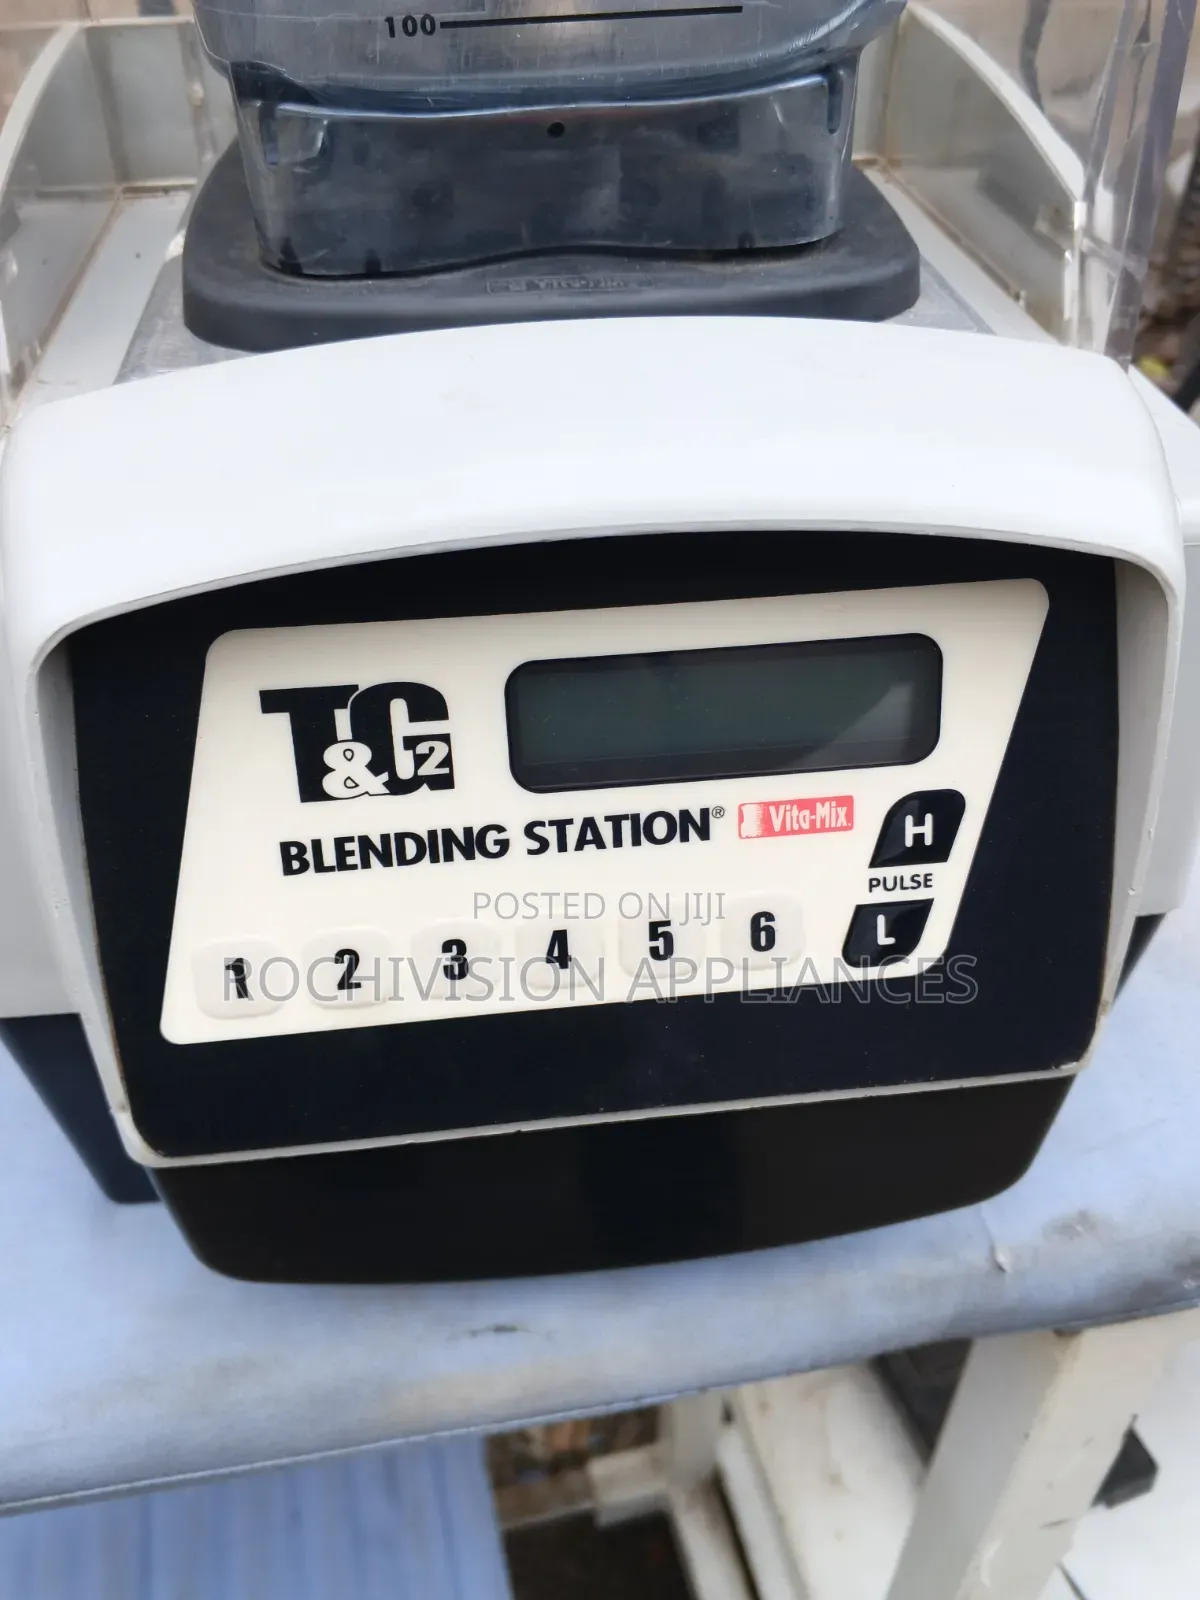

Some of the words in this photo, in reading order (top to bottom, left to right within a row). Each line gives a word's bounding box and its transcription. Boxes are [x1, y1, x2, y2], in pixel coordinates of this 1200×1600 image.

[384, 14, 436, 38] 100
[769, 801, 851, 832] Vita-Mix
[904, 813, 934, 848] H
[280, 824, 510, 876] BLENDING
[868, 872, 933, 893] PULSE
[876, 914, 896, 945] L
[225, 957, 249, 999] 1
[334, 948, 362, 991] 2
[441, 938, 469, 981] 3
[545, 929, 572, 970] 4
[648, 920, 674, 961] 5
[750, 911, 777, 952] 6
